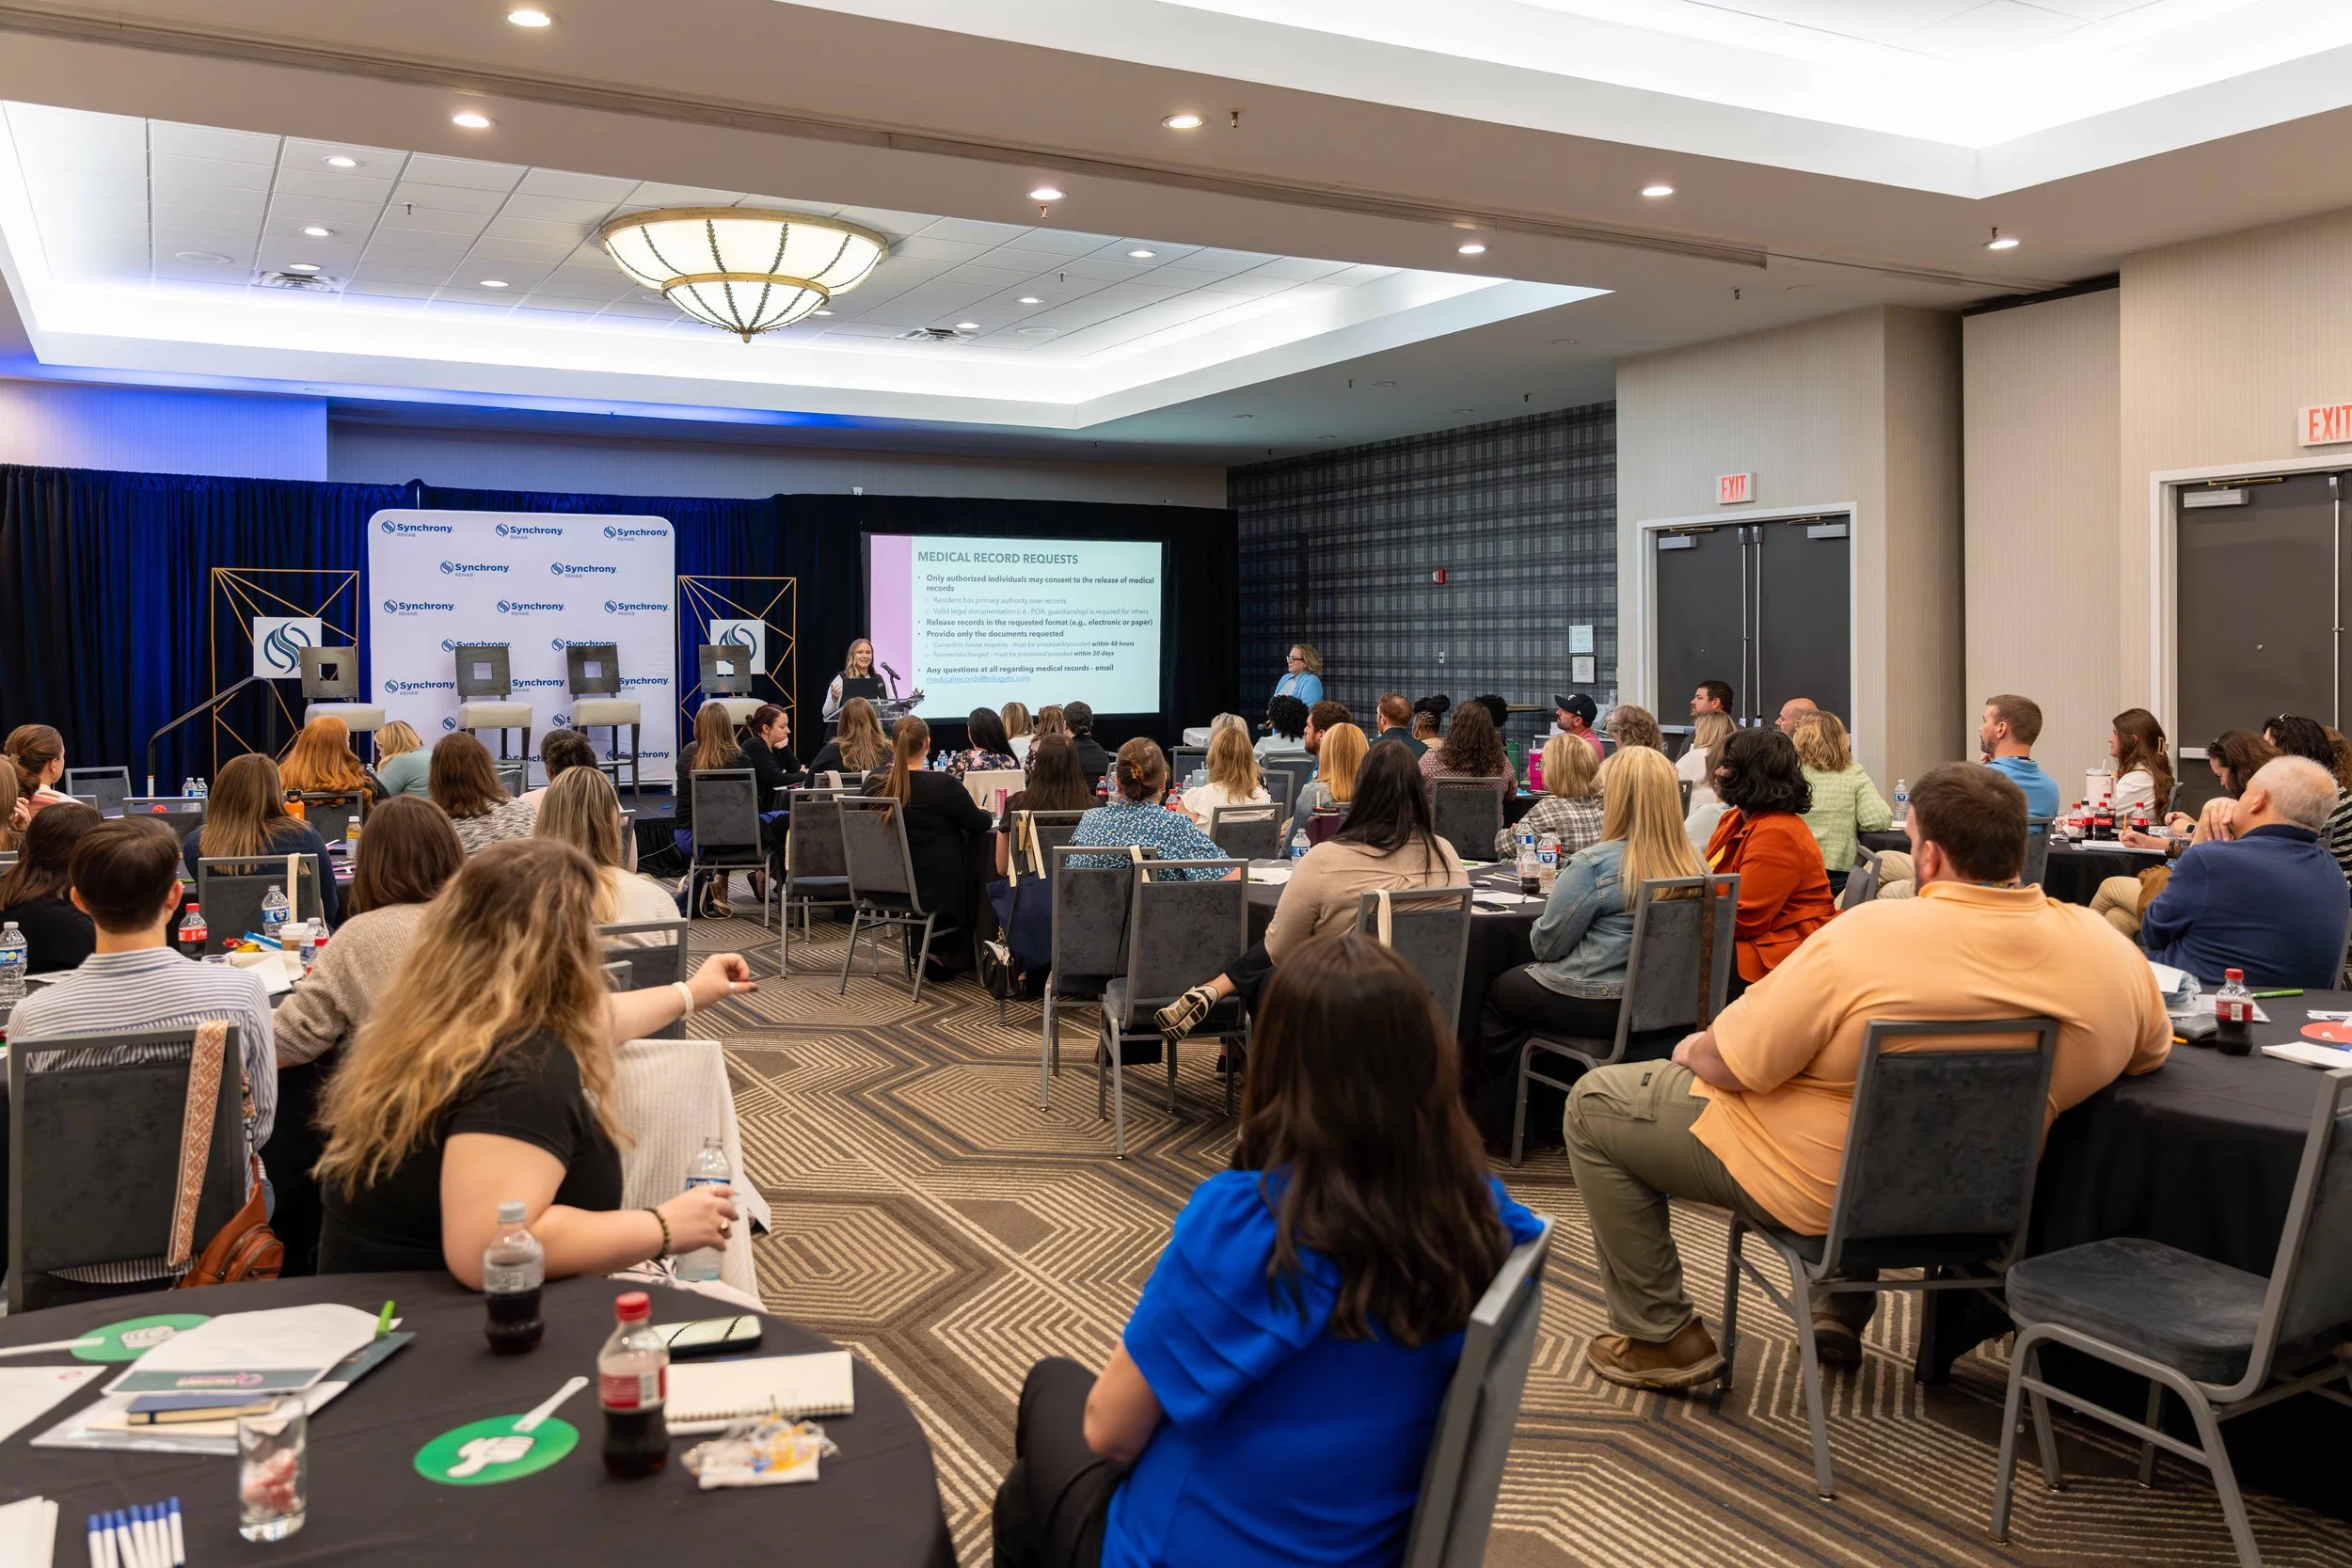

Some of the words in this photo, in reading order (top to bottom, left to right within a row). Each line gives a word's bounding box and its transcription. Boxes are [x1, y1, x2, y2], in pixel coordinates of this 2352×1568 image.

[2310, 404, 2352, 441] EXIT
[1722, 475, 1745, 500] EXIT
[397, 523, 453, 533] Synchrony
[510, 526, 563, 535] Synchrony
[917, 551, 971, 562] MEDICAL
[973, 553, 1020, 563] RECORD
[1024, 553, 1078, 564] REQUESTS
[455, 563, 509, 573] Synchrony
[565, 564, 616, 574] Synchrony
[927, 574, 945, 583] Only
[399, 602, 453, 610] Synchrony
[618, 603, 668, 611] Synchrony
[957, 630, 974, 639] only
[1028, 630, 1064, 639] requested
[999, 665, 1034, 673] regarding
[513, 678, 564, 687] Synchrony
